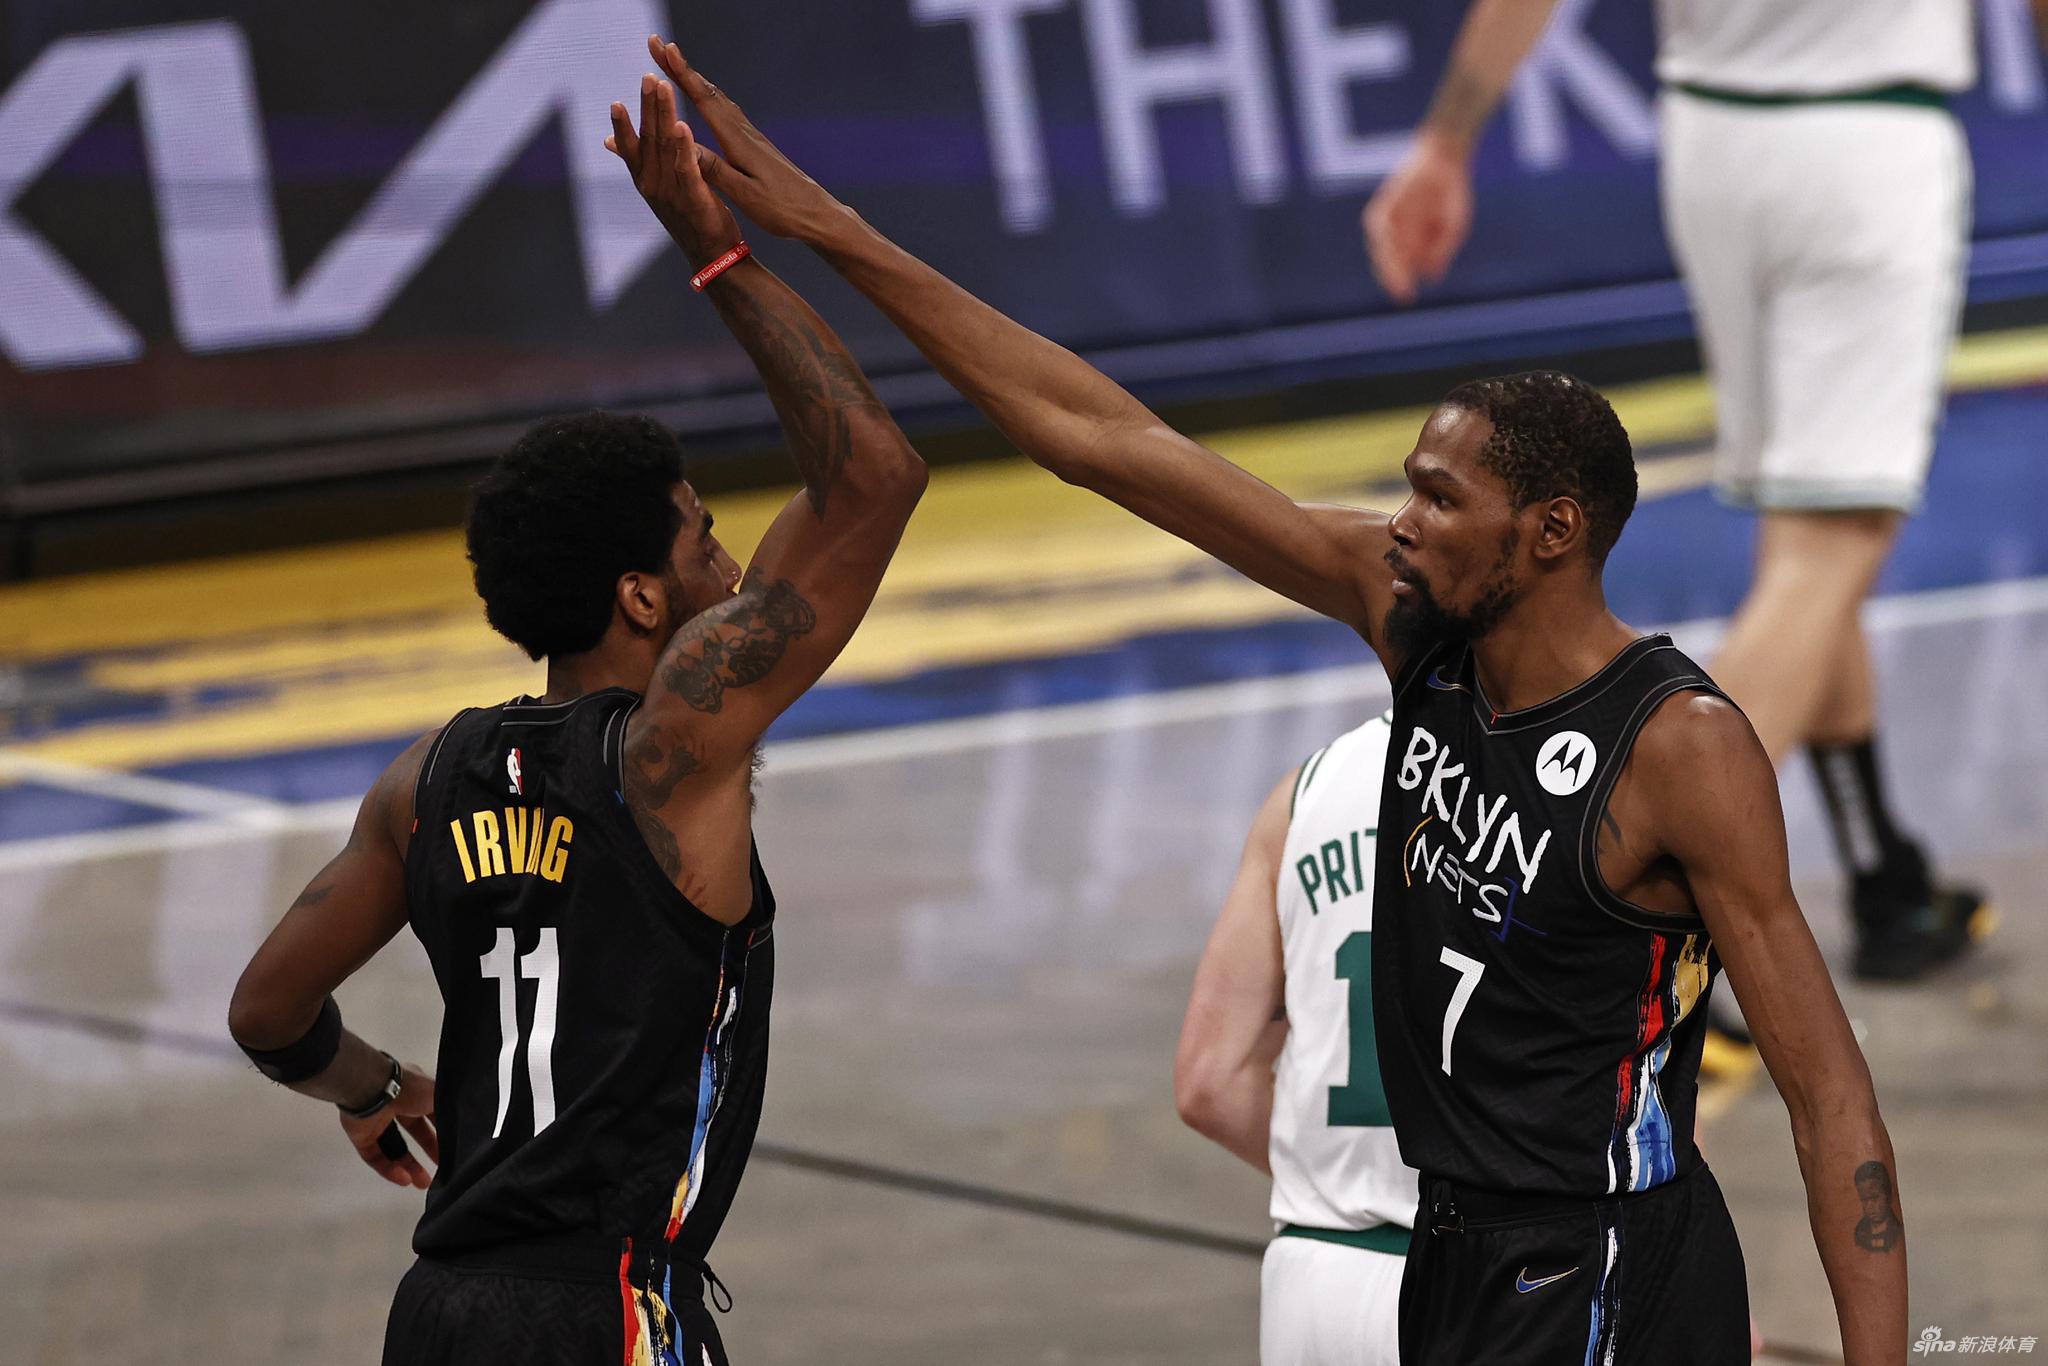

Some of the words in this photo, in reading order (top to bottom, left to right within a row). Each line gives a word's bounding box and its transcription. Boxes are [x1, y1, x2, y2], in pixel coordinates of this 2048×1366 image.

[908, 0, 1413, 234] THE
[450, 806, 574, 883] IRVIG
[1398, 726, 1552, 893] BKLYN
[1411, 833, 1509, 923] NETS
[480, 927, 560, 1138] 11
[1440, 946, 1486, 1077] 7
